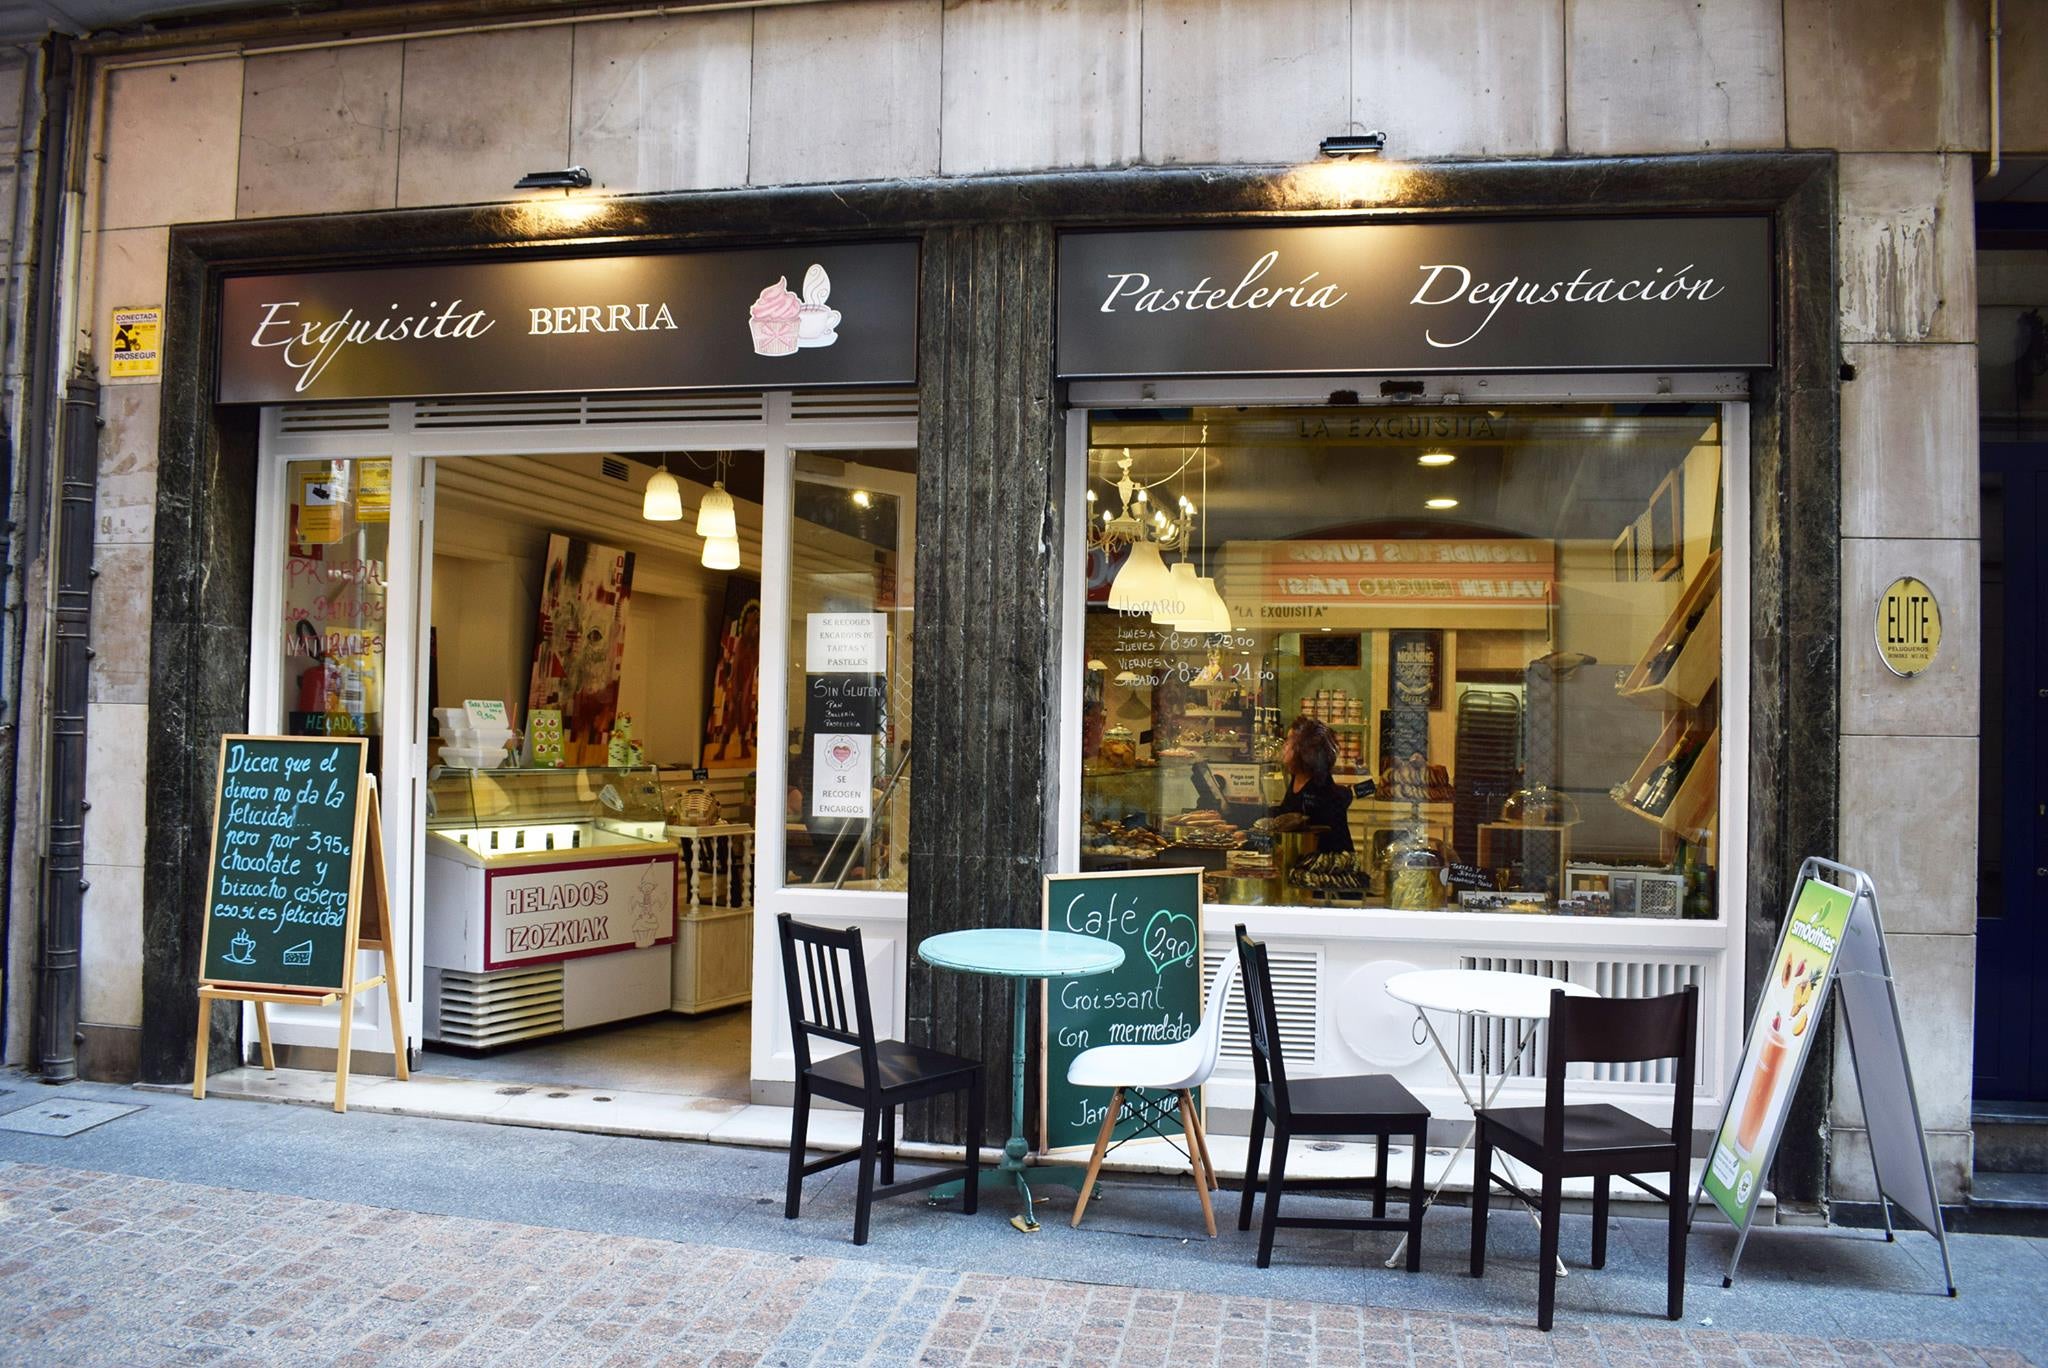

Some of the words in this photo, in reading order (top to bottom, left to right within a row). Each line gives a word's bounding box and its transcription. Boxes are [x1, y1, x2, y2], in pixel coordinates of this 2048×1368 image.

[1100, 251, 1347, 312] Pastelería
[1410, 265, 1724, 347] Degustación
[116, 313, 157, 321] CONECTADA
[114, 352, 156, 360] PROSEGUR
[251, 300, 496, 391] Exquisita
[528, 302, 678, 335] BERRIA
[1296, 416, 1330, 438] LA
[1347, 415, 1495, 439] EXQUISITA
[1888, 596, 1929, 643] ELITE
[226, 744, 280, 774] Dicen
[284, 757, 311, 781] que
[319, 747, 339, 773] el
[224, 776, 269, 800] dinero
[273, 786, 291, 803] no
[296, 778, 319, 805] da
[324, 778, 345, 809] la
[822, 790, 862, 799] RECOGEN
[836, 775, 848, 784] SE
[819, 805, 864, 814] ENCARGOS
[223, 830, 260, 854] pero
[266, 833, 300, 858] por
[221, 848, 301, 875] chocolate
[312, 861, 329, 886] y
[220, 875, 287, 900] bizcocho
[294, 887, 349, 907] casero
[506, 880, 609, 916] HELADOS
[214, 903, 239, 917] eso
[258, 908, 277, 920] es
[272, 901, 346, 934] felicidad
[1066, 893, 1139, 942] Café
[506, 916, 609, 954] IZOZKIAK
[1791, 919, 1837, 956] smoothies
[1061, 974, 1165, 1011] Croissant
[1109, 1012, 1193, 1043] mermelada
